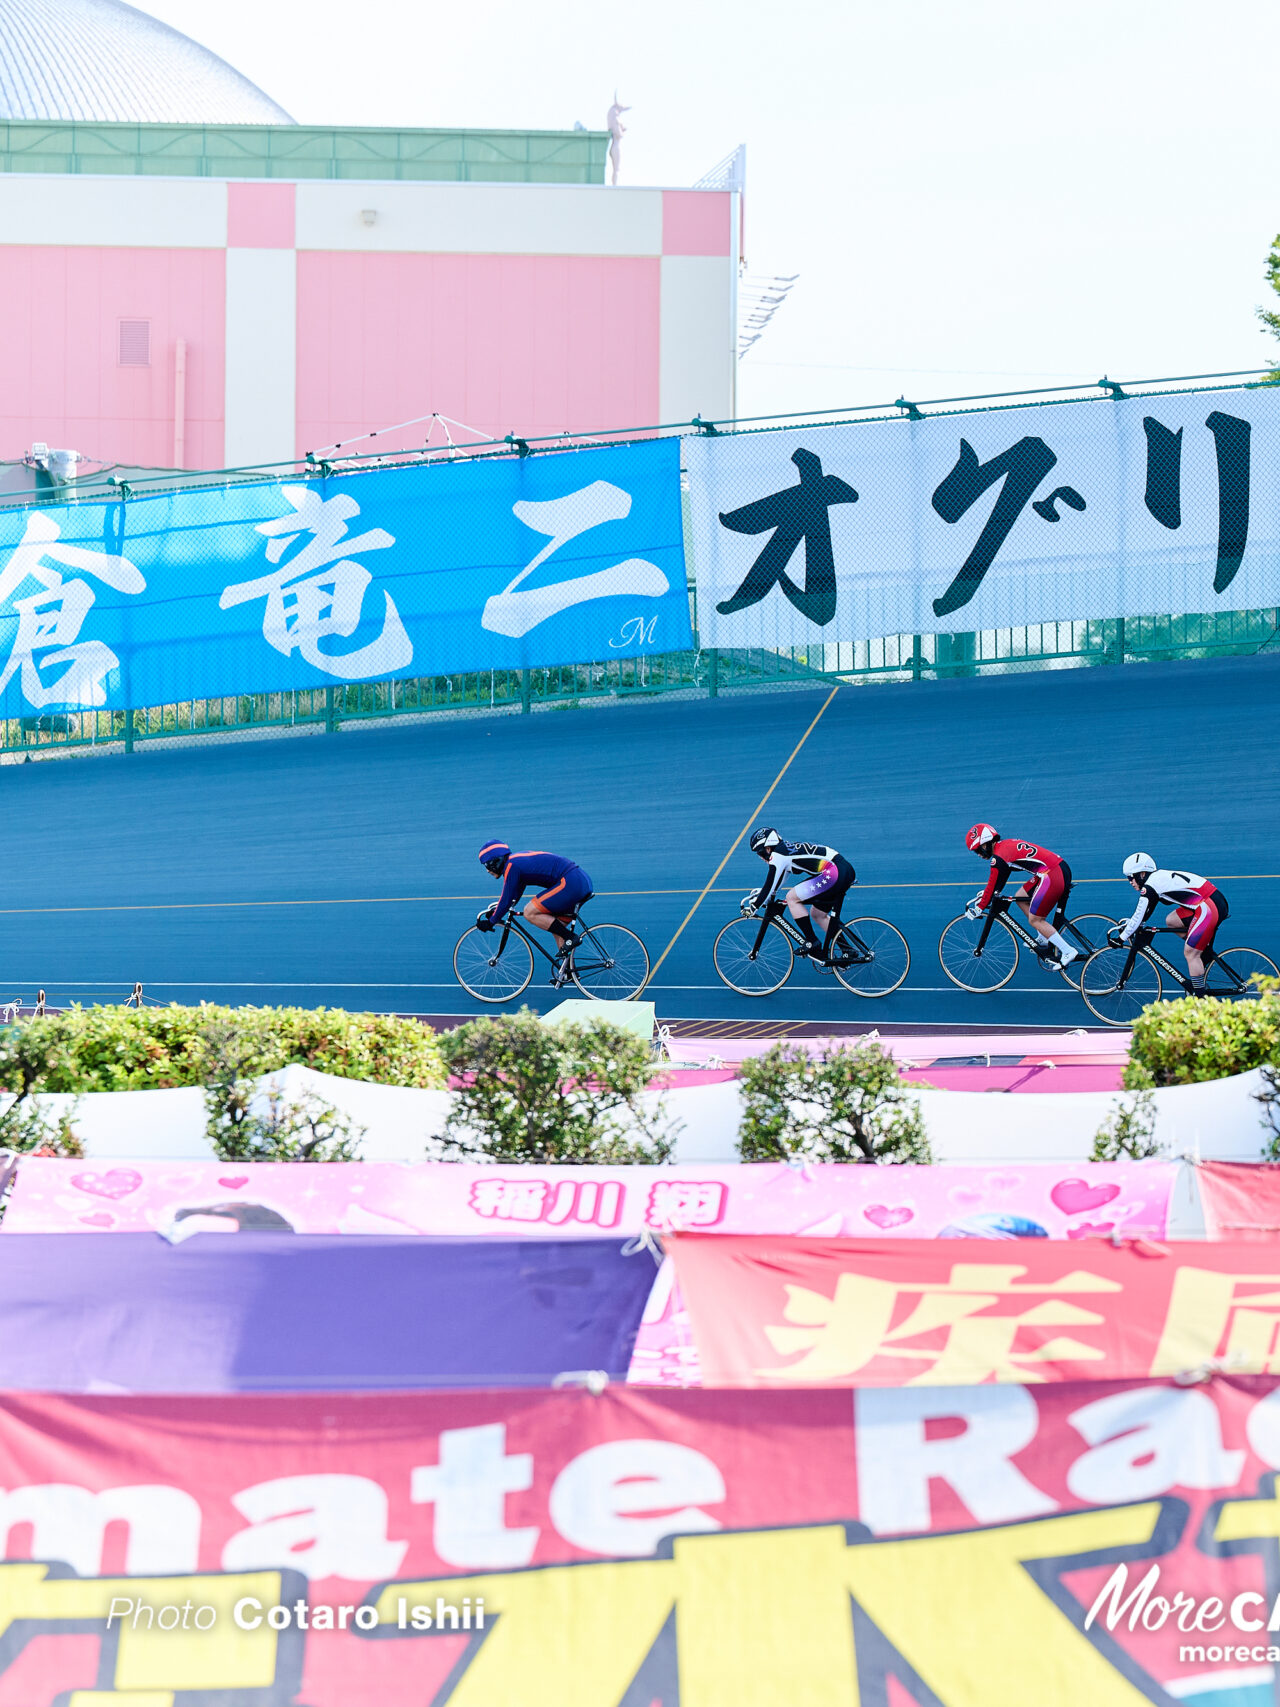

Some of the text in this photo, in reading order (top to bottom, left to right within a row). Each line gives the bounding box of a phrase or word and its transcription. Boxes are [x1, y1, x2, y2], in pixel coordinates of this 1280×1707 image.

[970, 827, 978, 839] 3
[1016, 842, 1037, 858] 3
[999, 911, 1038, 949] BRIDGESTONE
[1142, 945, 1186, 983] BRIDGESTONE
